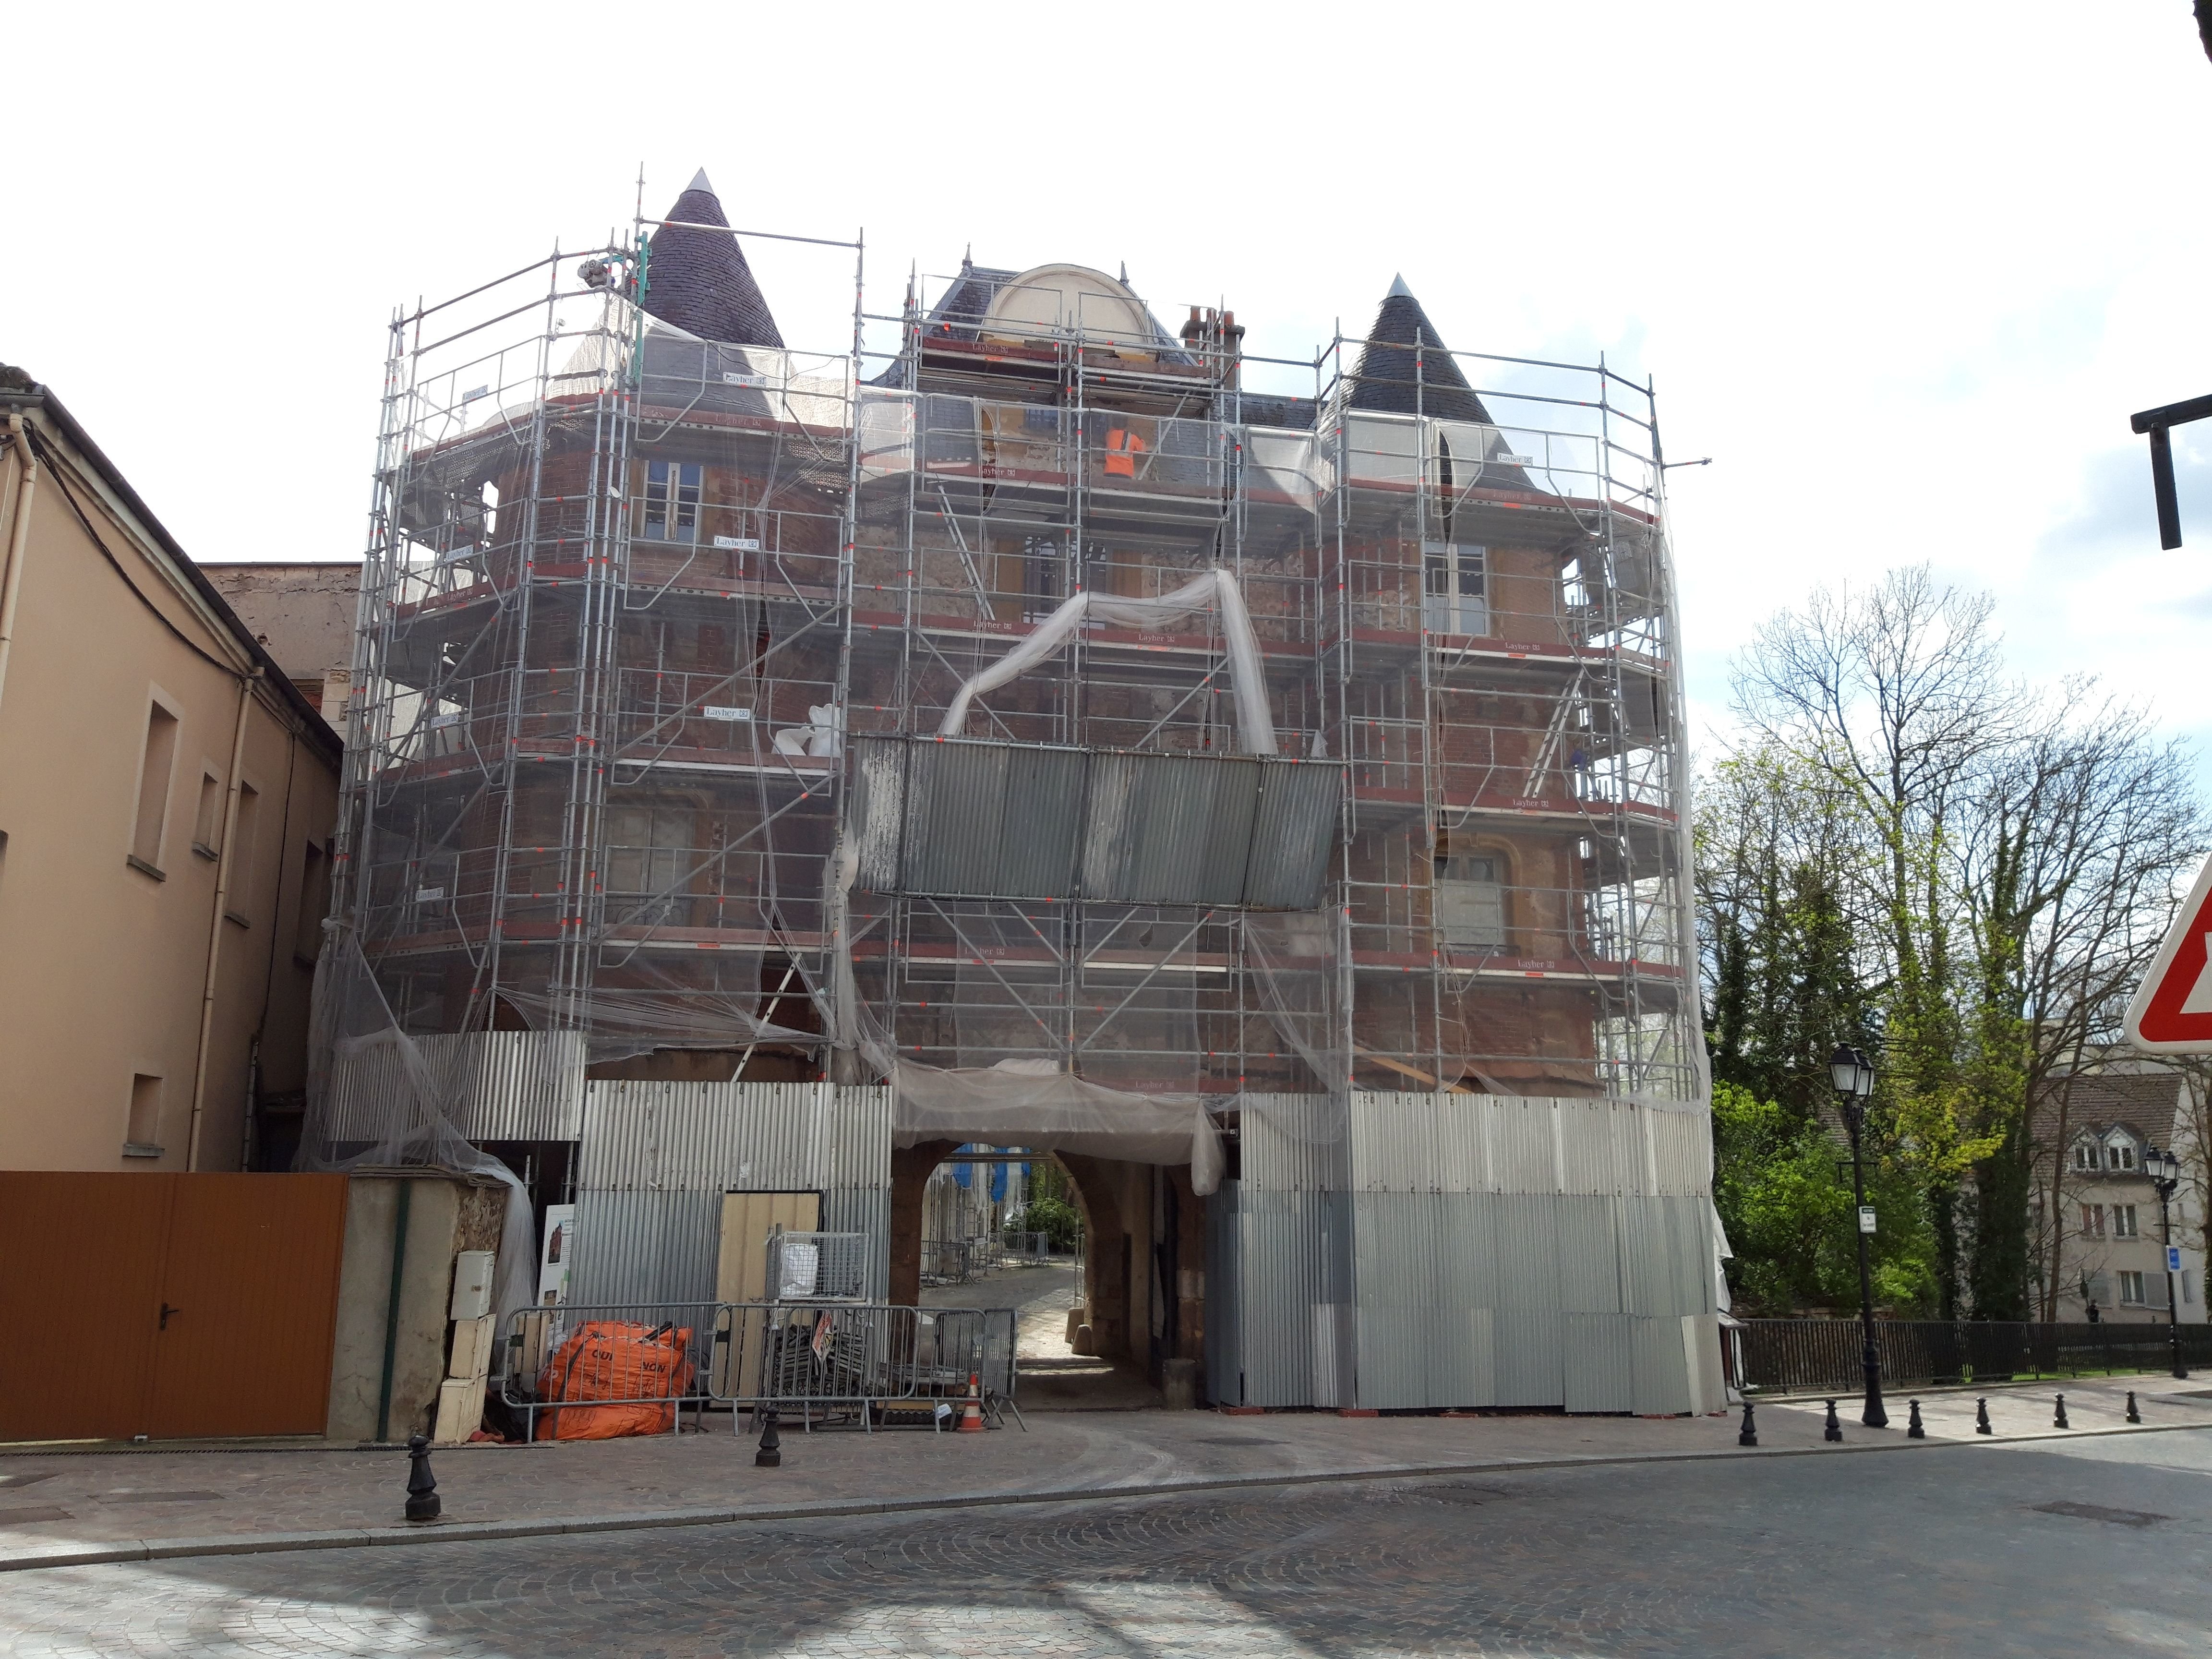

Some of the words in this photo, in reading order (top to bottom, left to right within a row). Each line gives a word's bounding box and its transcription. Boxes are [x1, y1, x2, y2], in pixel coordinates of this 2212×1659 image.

[972, 343, 998, 352] Layher
[726, 373, 753, 384] Layher
[1499, 454, 1522, 463] Layher
[716, 537, 745, 547] Layher
[974, 620, 1001, 629] Layher
[1139, 634, 1165, 643] Layher
[1505, 642, 1530, 651] Layher
[707, 708, 736, 718] Layher
[1513, 799, 1539, 807] Layher
[965, 947, 993, 955] Lher
[1518, 960, 1544, 969] Layher
[591, 1349, 613, 1361] OUI
[640, 1361, 666, 1373] NON
